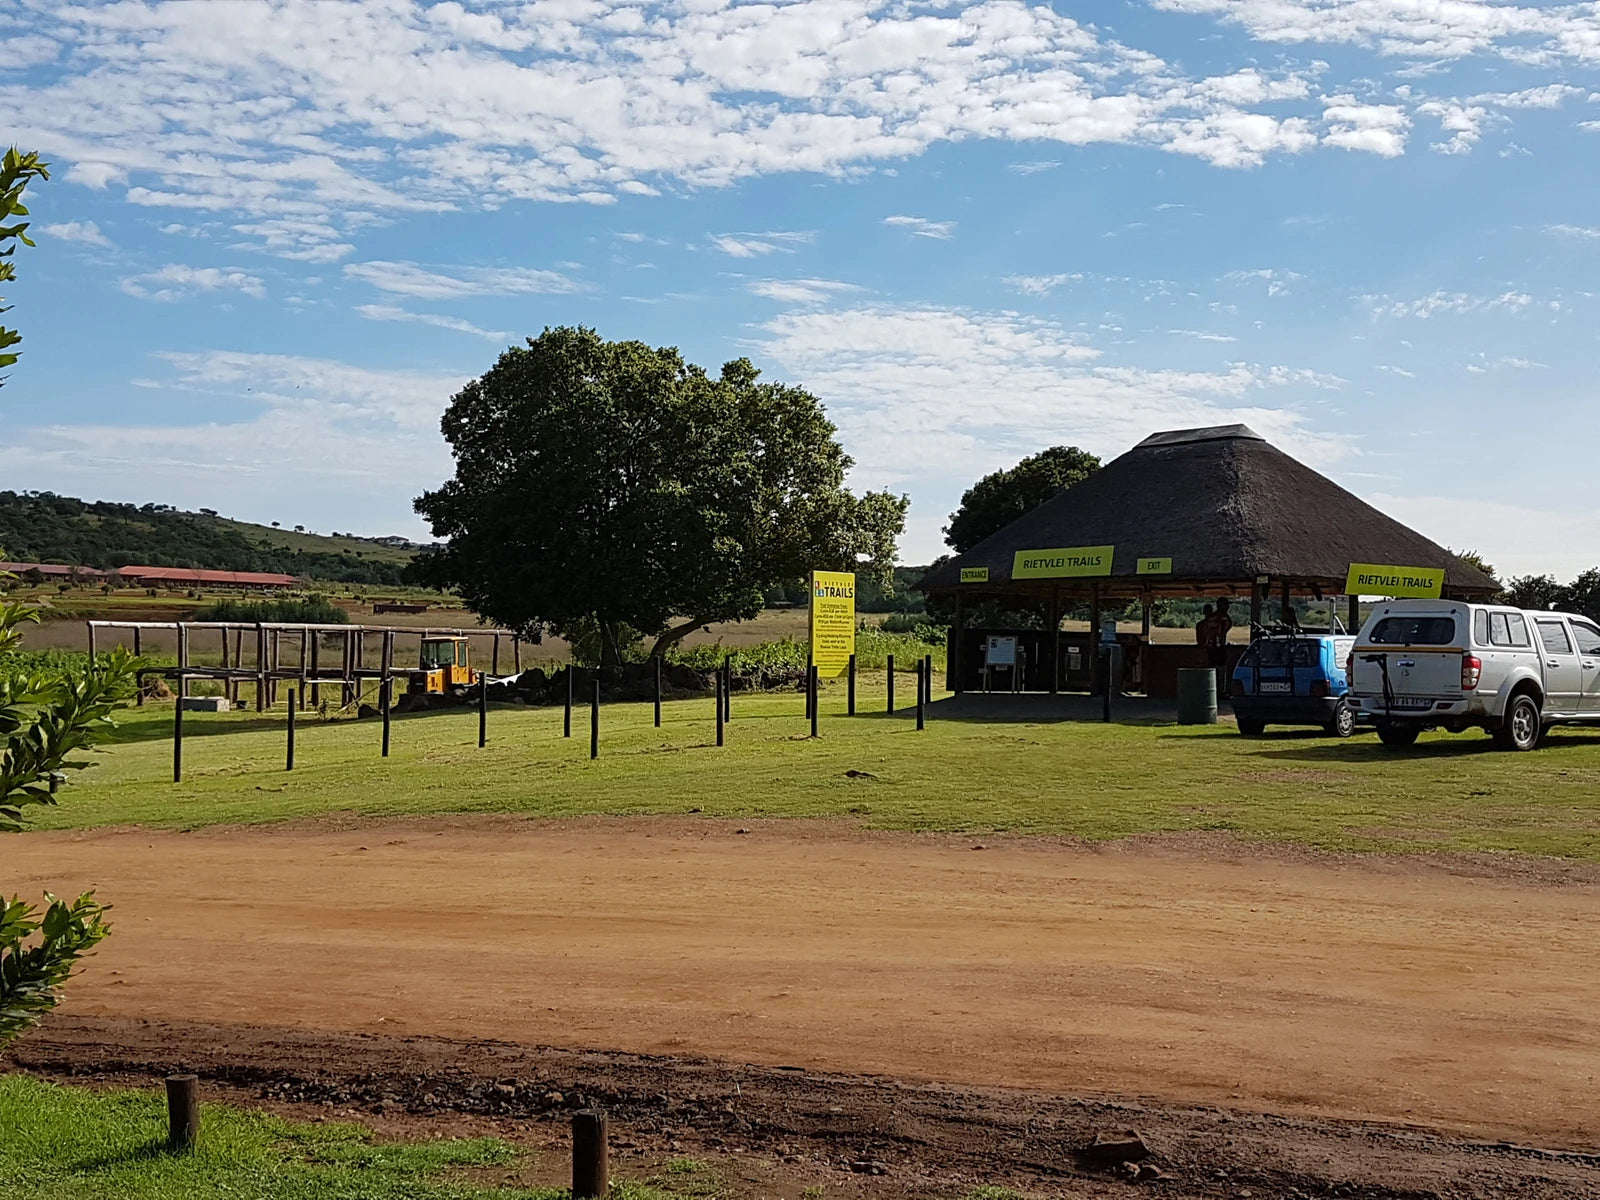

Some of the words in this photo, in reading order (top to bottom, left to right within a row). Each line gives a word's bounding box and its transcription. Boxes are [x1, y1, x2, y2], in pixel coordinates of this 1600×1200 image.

[1023, 557, 1065, 569] RIETVLEI
[1067, 555, 1102, 567] TRAILS
[1147, 561, 1161, 570] EXIT
[1357, 574, 1400, 587] RIETVLEI
[1402, 576, 1433, 588] TRAILS
[824, 586, 853, 598] TRAILS
